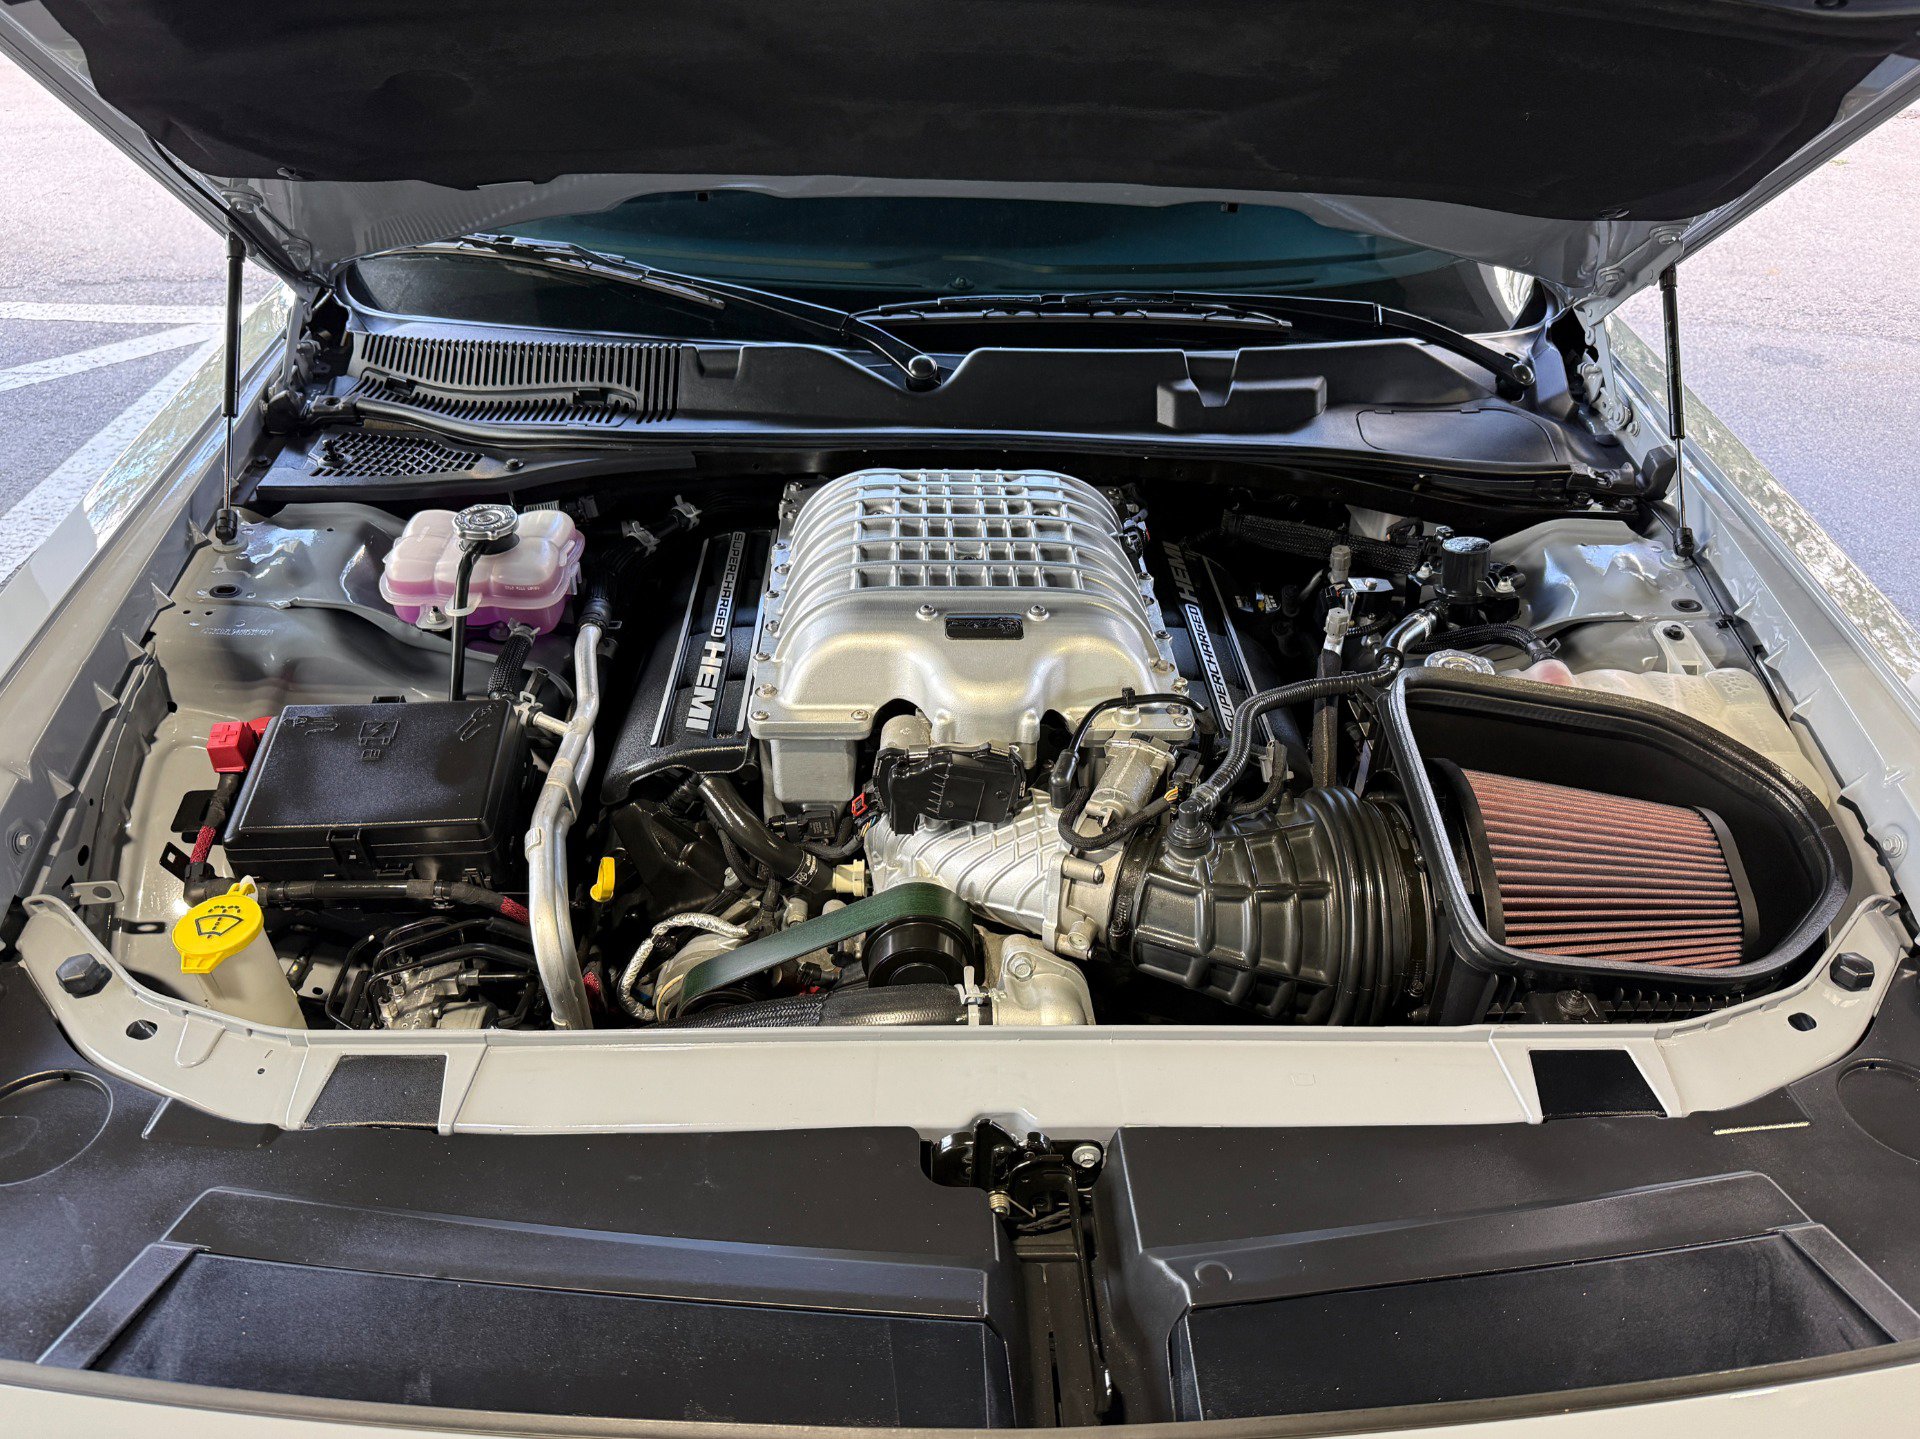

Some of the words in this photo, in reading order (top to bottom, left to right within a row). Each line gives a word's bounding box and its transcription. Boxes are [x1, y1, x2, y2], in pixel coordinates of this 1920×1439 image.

[713, 532, 744, 635] SUPERCHARGED
[1164, 541, 1198, 603] HEMI
[686, 641, 726, 731] HEMI
